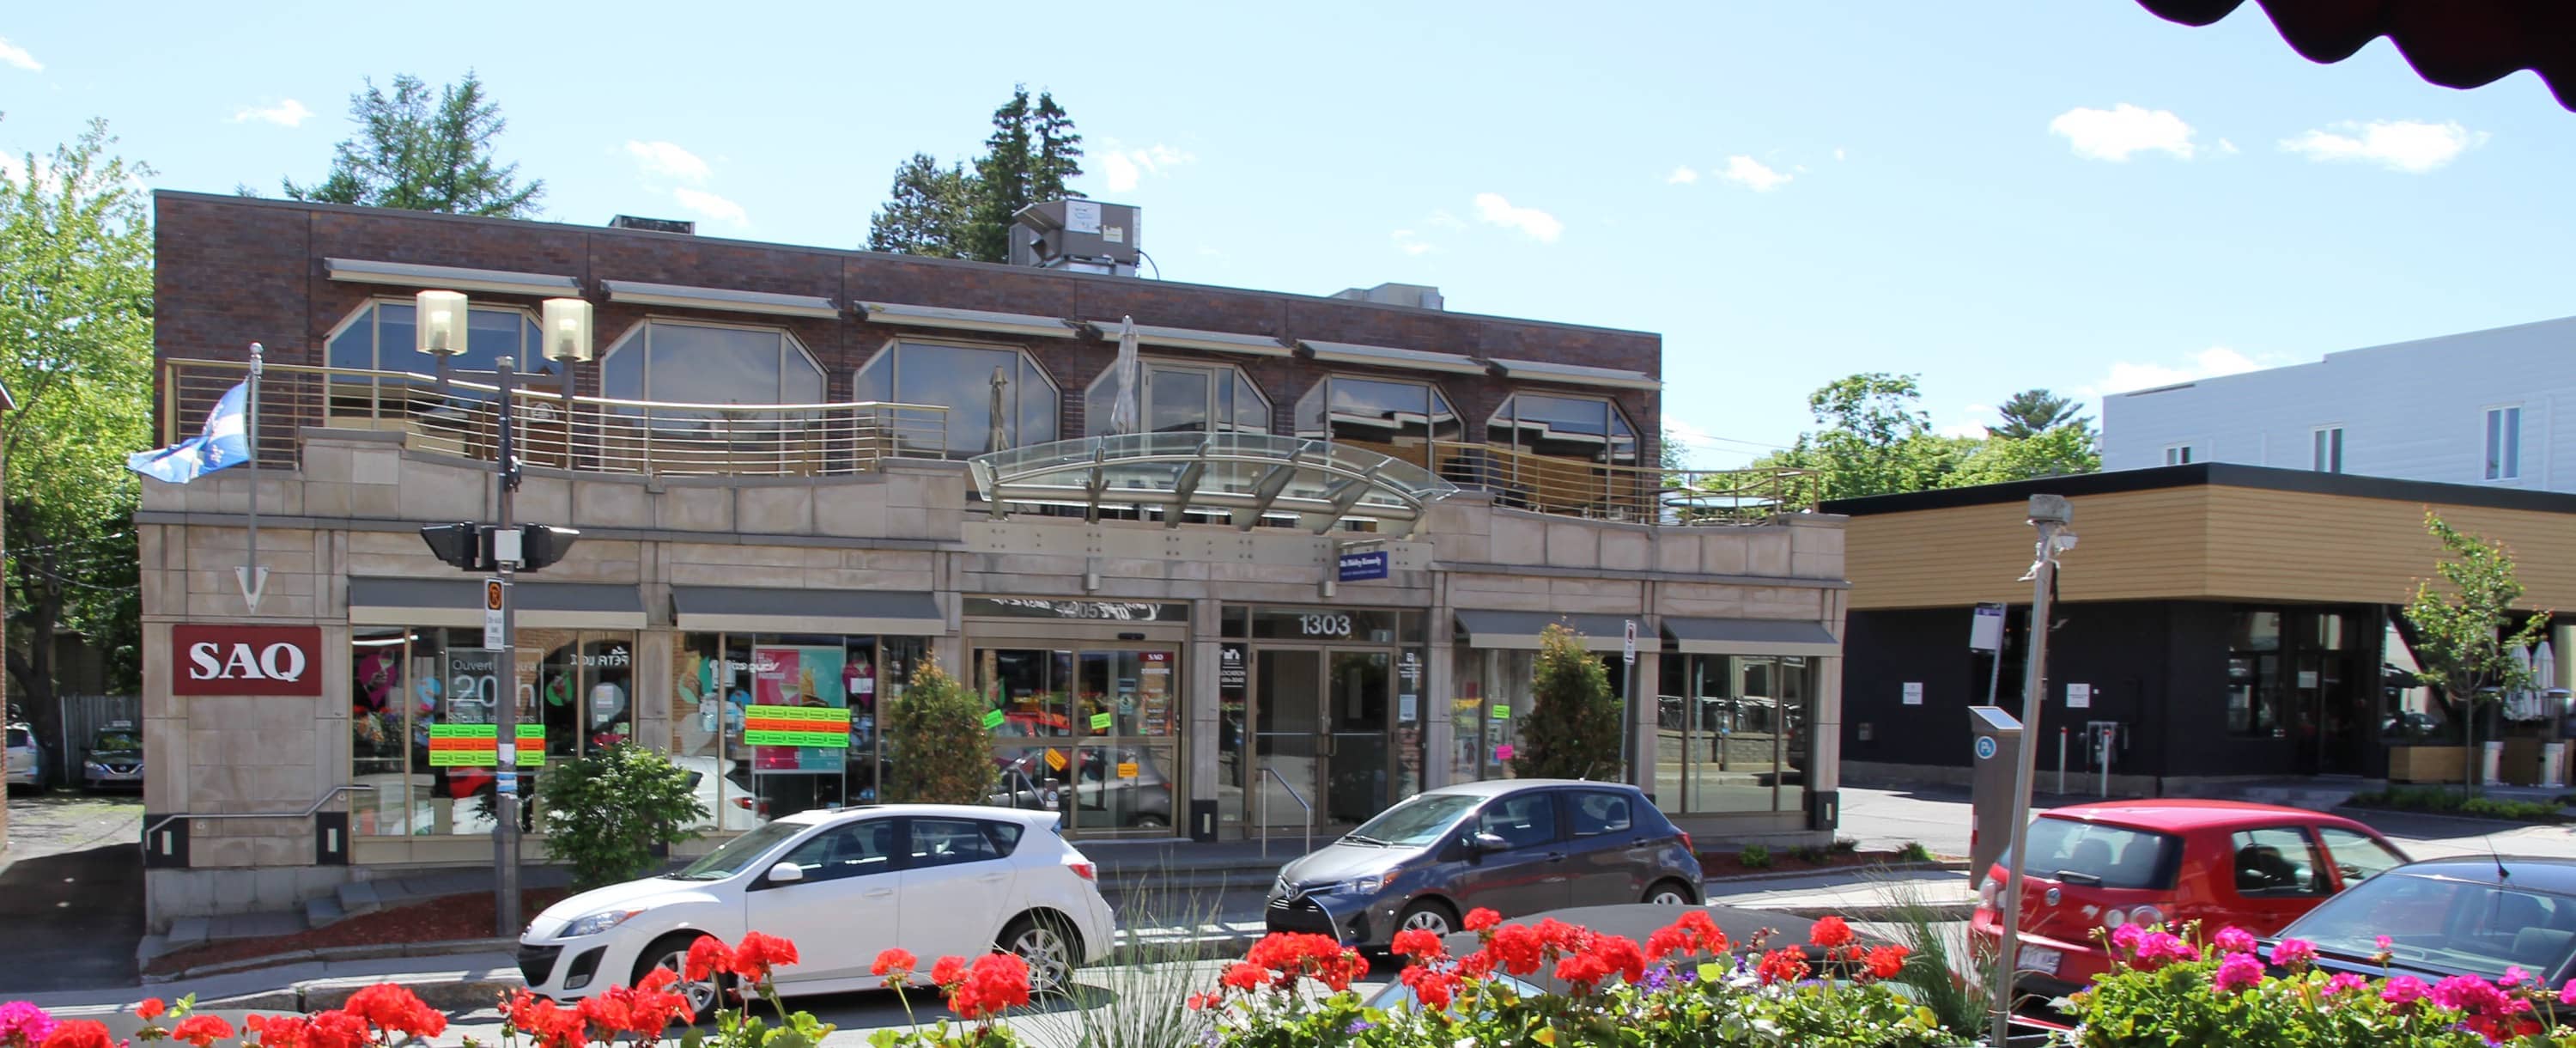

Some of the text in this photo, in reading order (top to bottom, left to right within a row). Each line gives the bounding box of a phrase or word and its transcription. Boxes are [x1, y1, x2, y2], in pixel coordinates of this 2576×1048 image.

[1299, 614, 1351, 636] 1303
[189, 642, 307, 682] SAQ
[452, 659, 494, 671] Ouvert
[453, 674, 536, 708] 20 h
